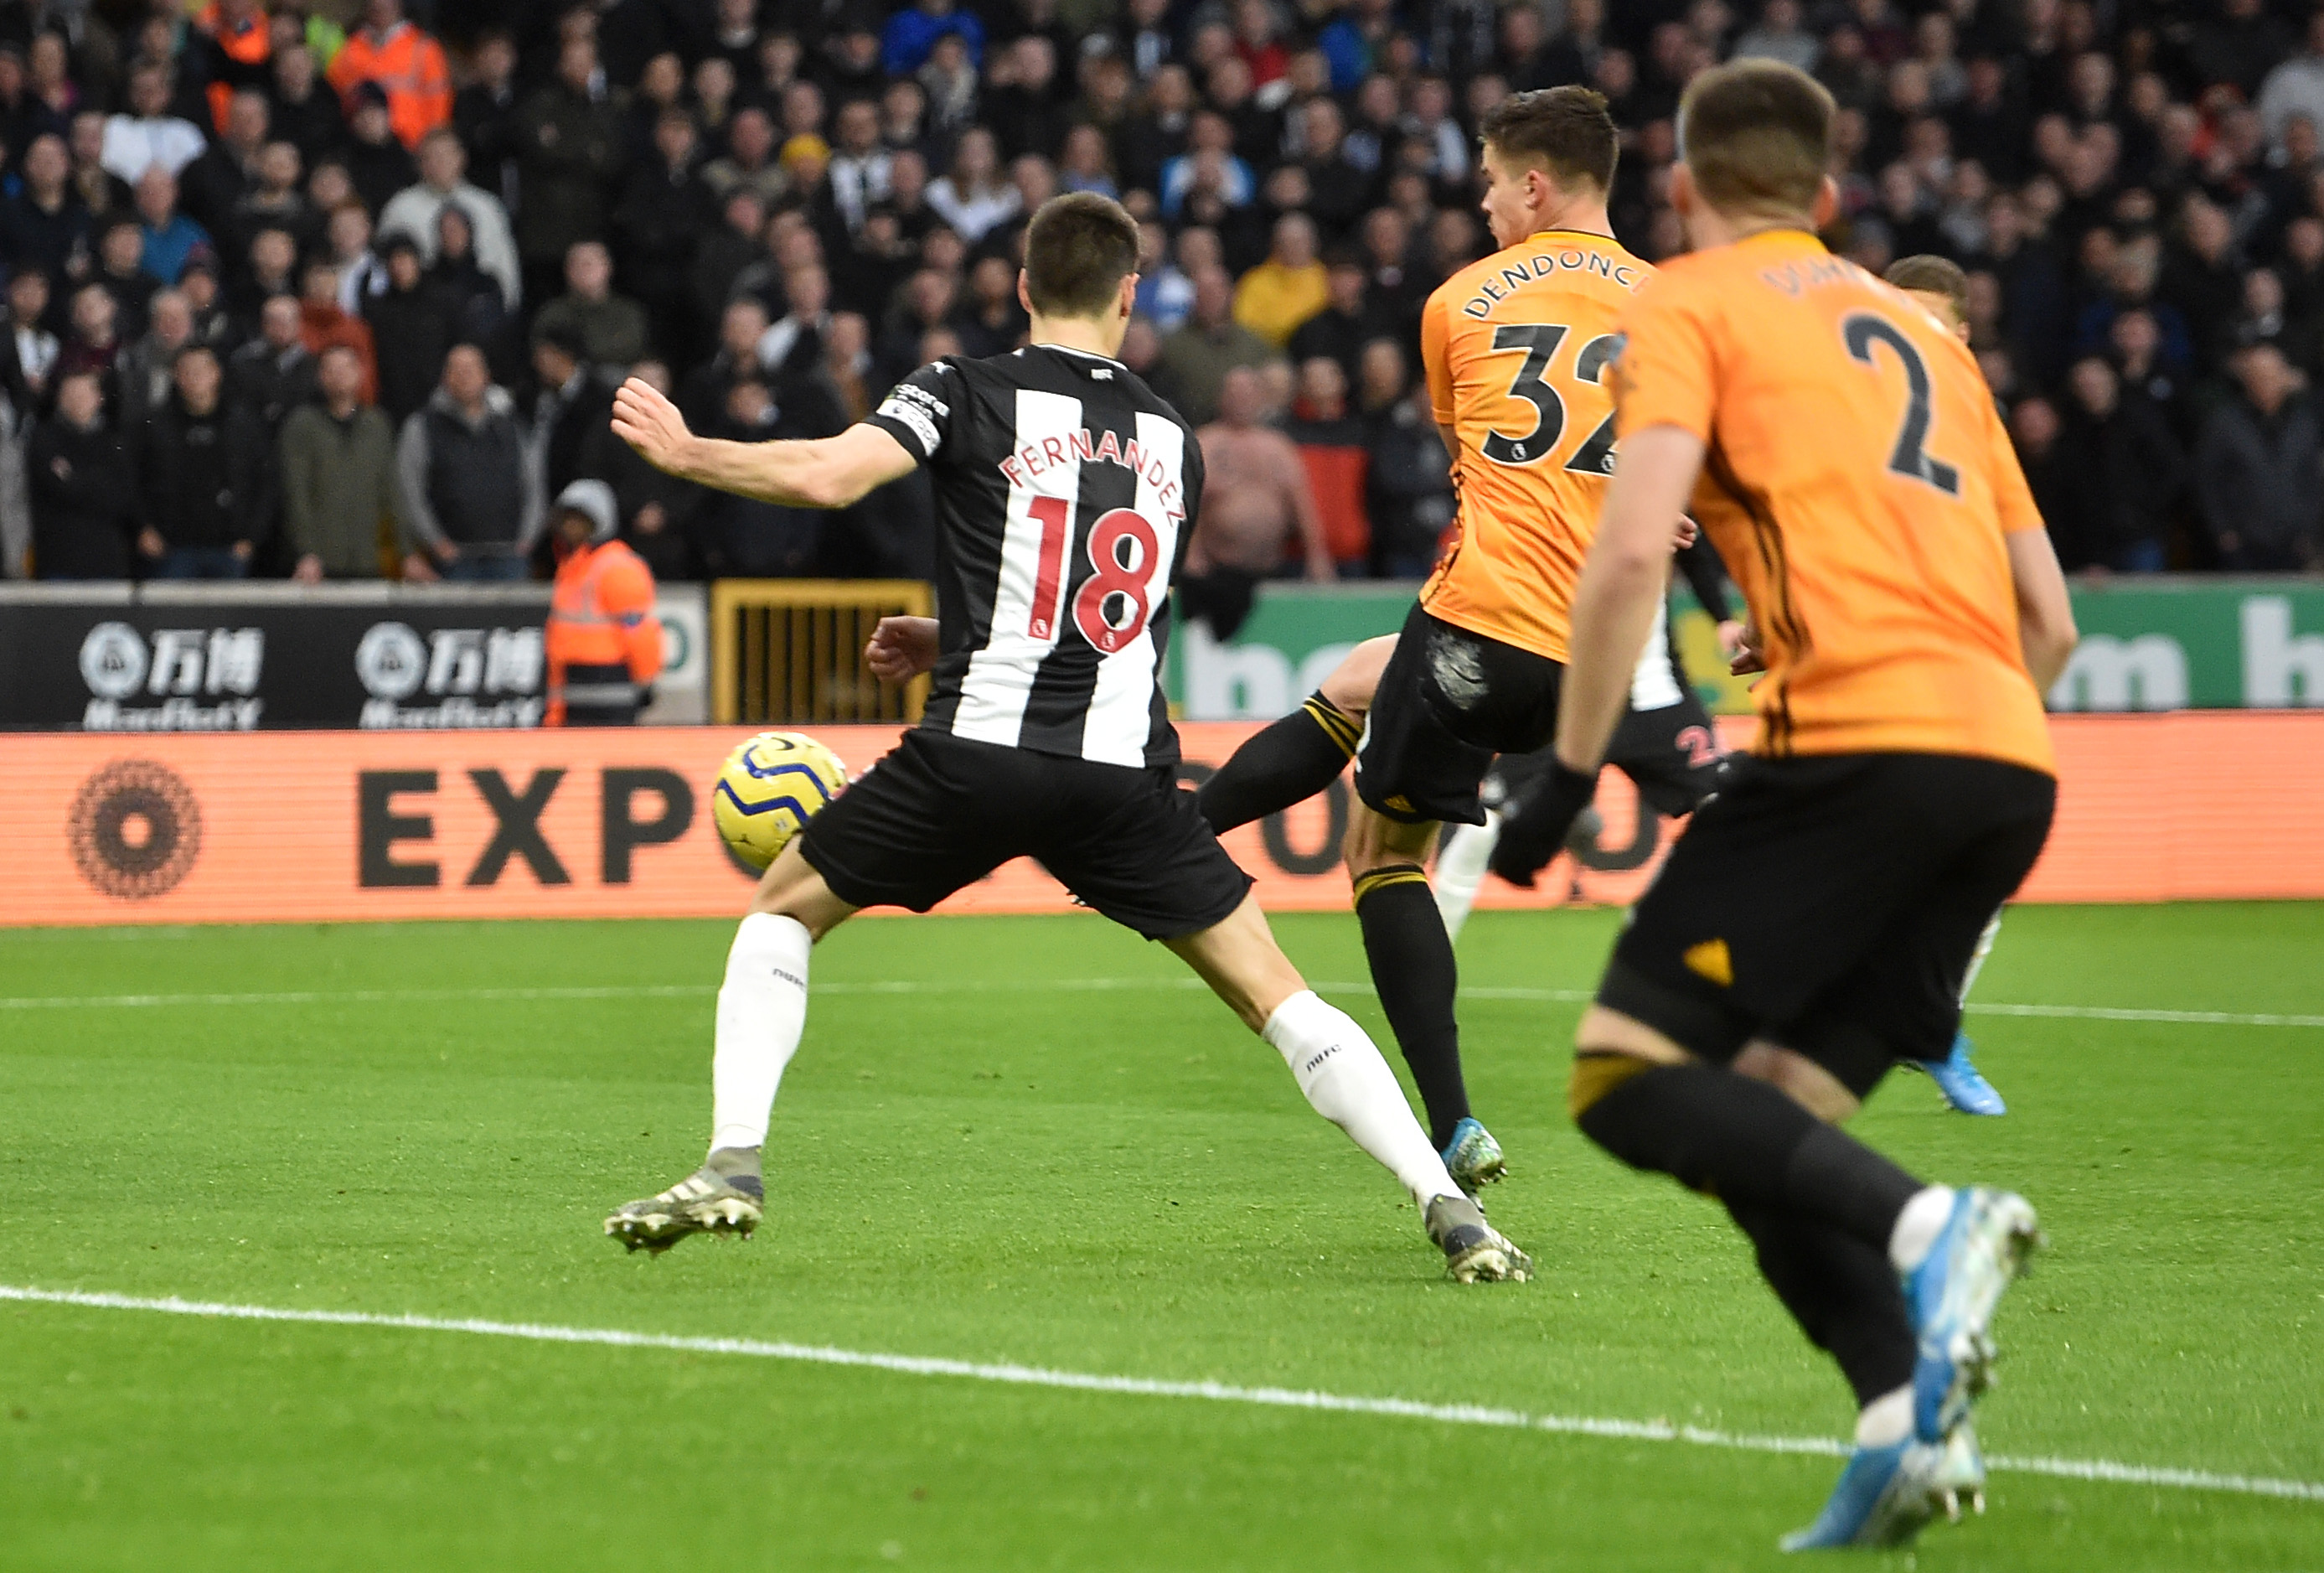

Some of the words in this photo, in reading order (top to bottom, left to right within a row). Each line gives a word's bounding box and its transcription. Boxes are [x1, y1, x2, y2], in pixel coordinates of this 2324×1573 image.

[1481, 324, 1619, 476] 32
[1843, 313, 1960, 494] 2
[998, 428, 1186, 527] FERNANDEZ
[1026, 494, 1158, 655] 18
[358, 767, 767, 888] EXP
